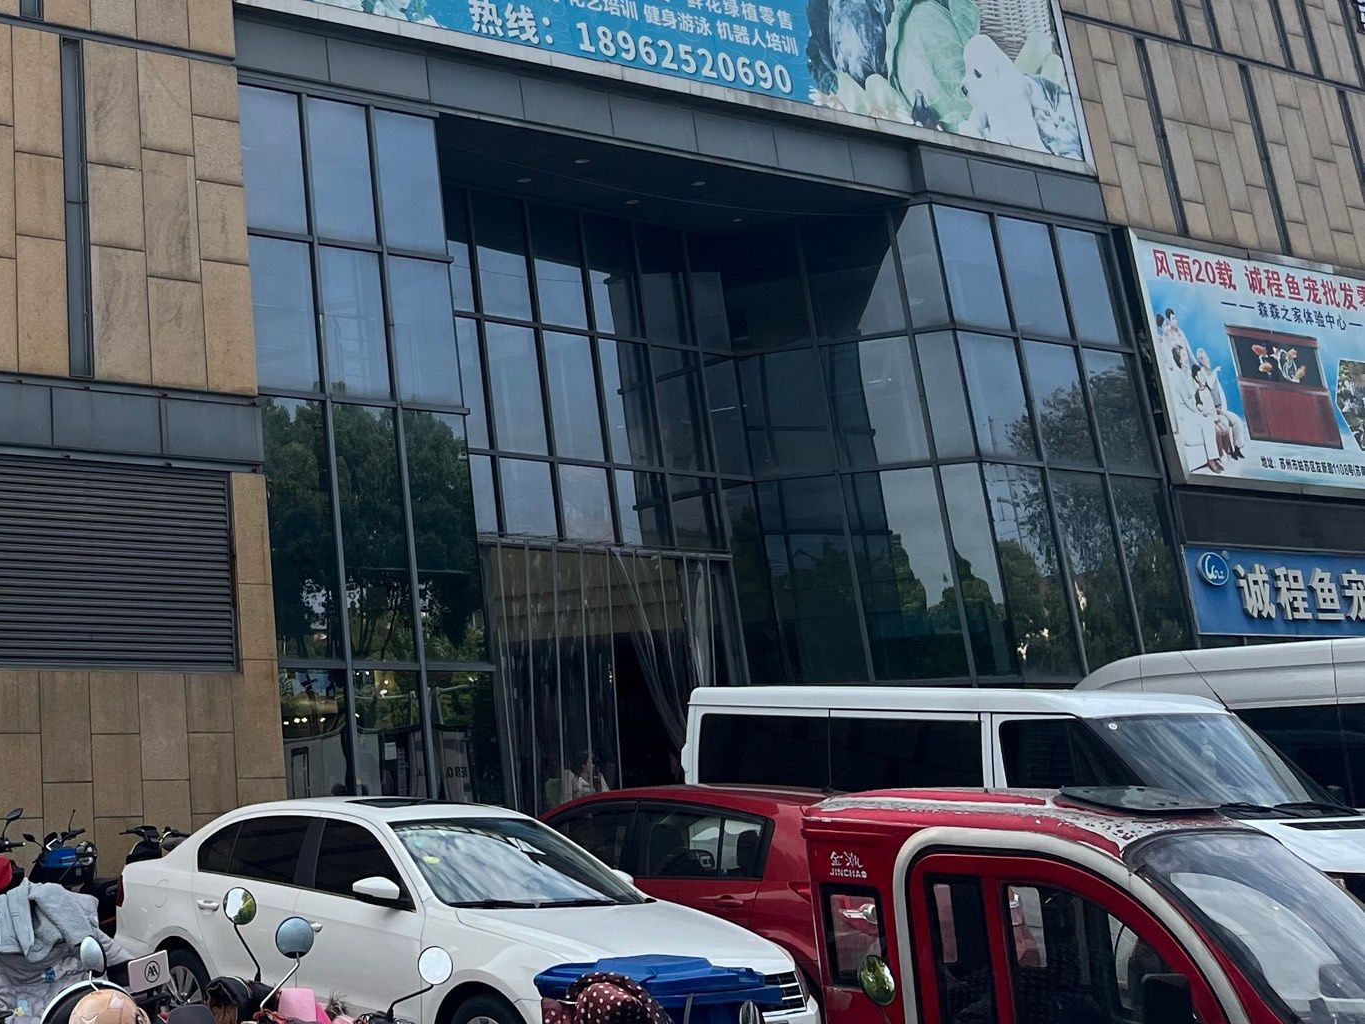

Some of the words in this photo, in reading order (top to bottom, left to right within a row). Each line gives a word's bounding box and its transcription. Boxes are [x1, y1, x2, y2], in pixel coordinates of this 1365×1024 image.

[643, 4, 713, 37] 健身游泳
[716, 20, 799, 56] 机器人培训
[576, 22, 792, 94] 18962520690
[1153, 249, 1237, 291] 风雨20载
[830, 868, 867, 879] JINCHAO
